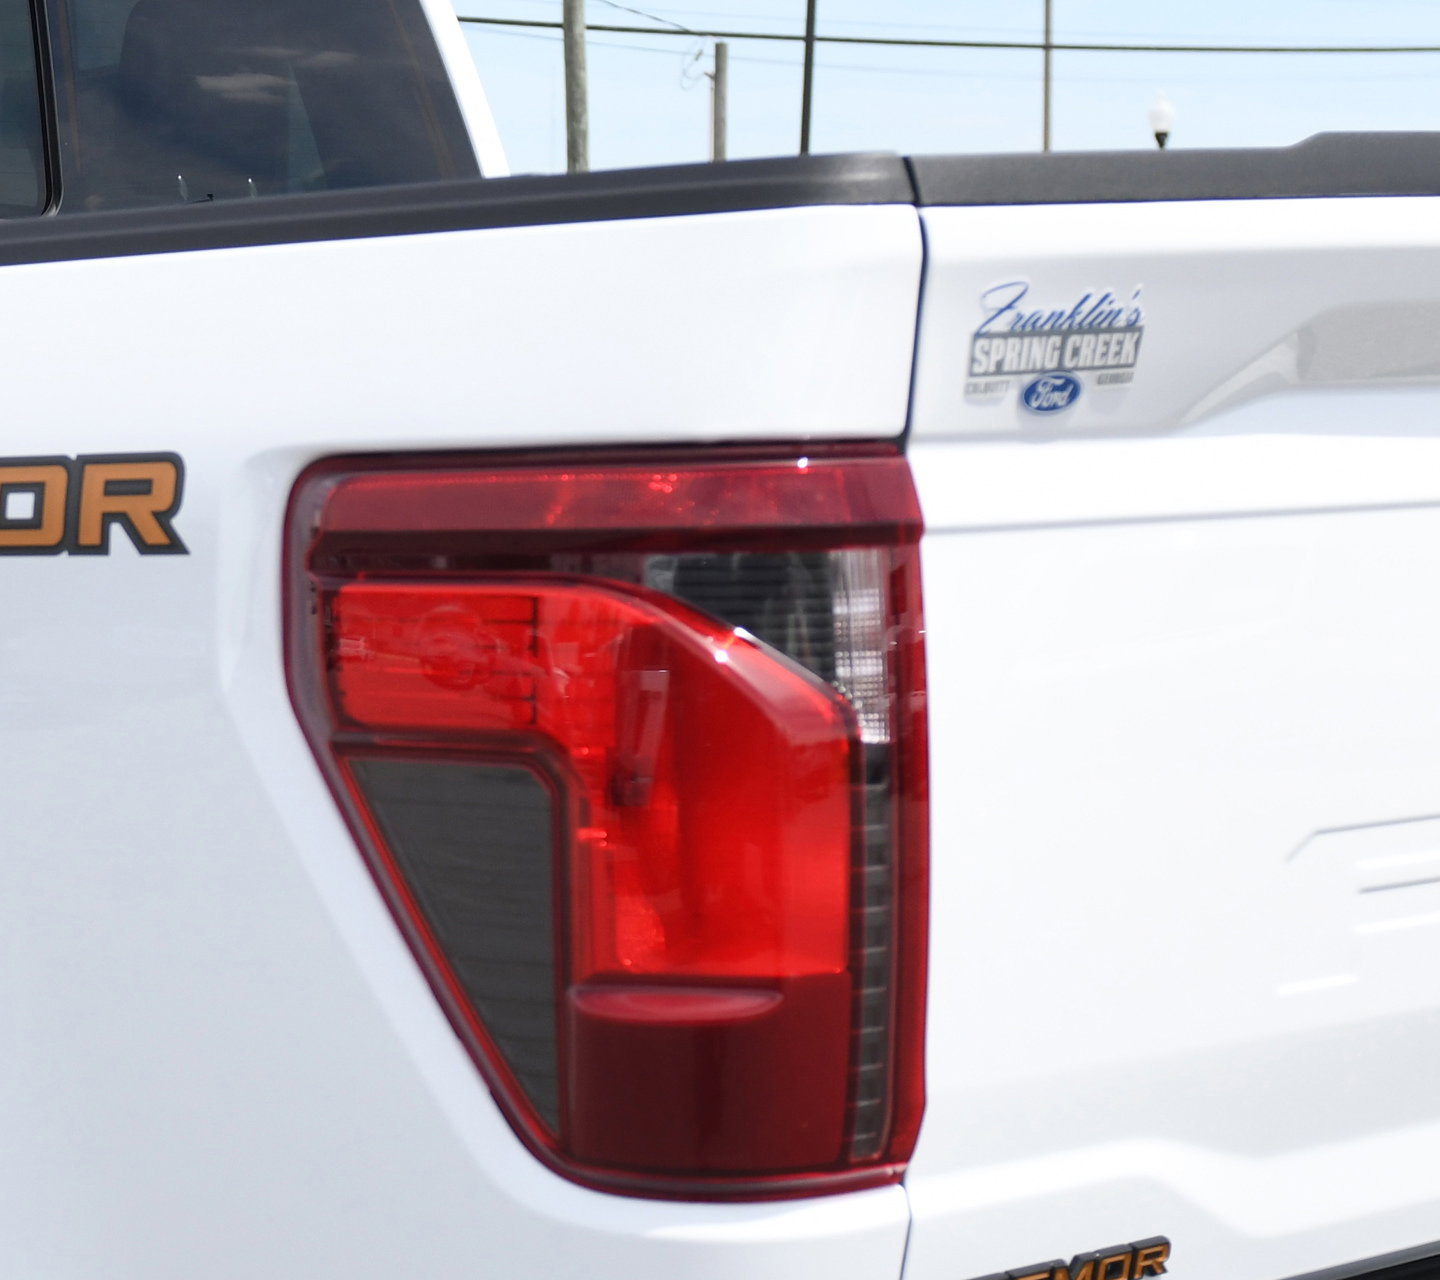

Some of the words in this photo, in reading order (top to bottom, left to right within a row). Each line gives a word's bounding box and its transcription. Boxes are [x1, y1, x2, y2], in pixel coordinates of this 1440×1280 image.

[975, 281, 1142, 336] Franklin's
[972, 335, 1063, 374] SPRING
[1064, 331, 1140, 368] CREEK
[1030, 376, 1074, 409] Ford
